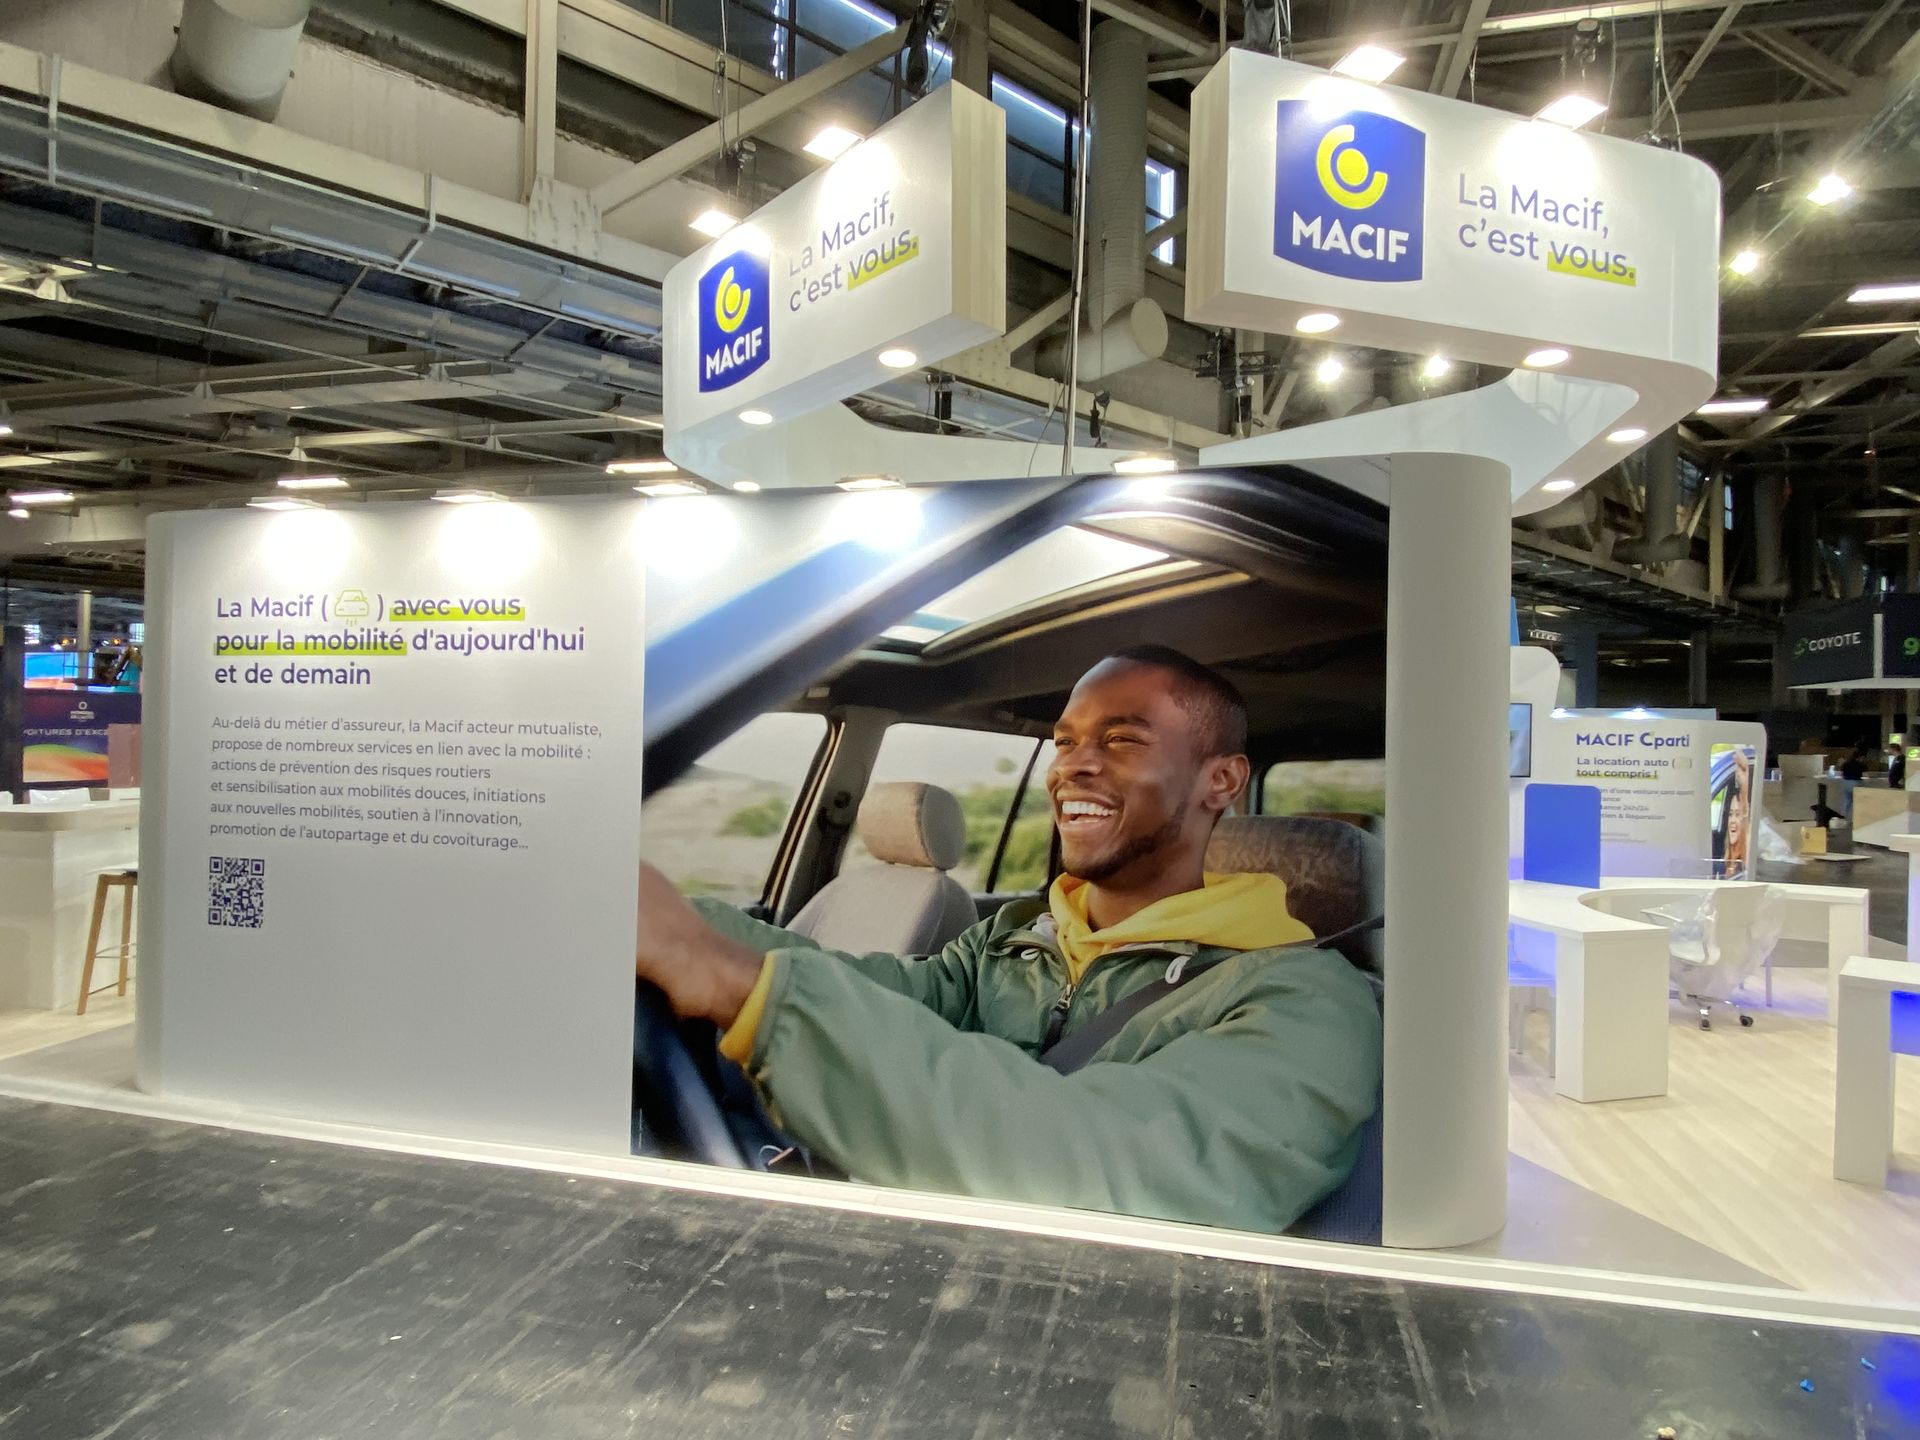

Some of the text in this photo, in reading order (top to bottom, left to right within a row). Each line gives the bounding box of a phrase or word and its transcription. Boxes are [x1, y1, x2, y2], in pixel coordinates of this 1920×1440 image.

[1459, 173, 1609, 239] La Macif,
[788, 190, 895, 277] La Macif,
[1292, 211, 1409, 263] MACIF
[1459, 218, 1635, 279] c'est vous.
[789, 229, 918, 312] c'est vous.
[705, 326, 763, 380] MACIF
[217, 598, 242, 617] La
[251, 594, 314, 617] Macif
[393, 599, 451, 616] avec
[459, 598, 521, 616] vous
[216, 627, 584, 656] pour la mobilité d'aujourd'hui
[1808, 632, 1861, 651] COYOTE
[215, 661, 371, 684] et de demain
[212, 717, 602, 738] Au-delà du métier d'assureur, la Macif acteur mutualiste,
[1576, 733, 1635, 746] MACIF
[212, 739, 263, 752] propose
[266, 738, 282, 751] de
[286, 739, 354, 752] nombreux
[357, 741, 412, 754] services
[416, 743, 433, 754] en
[438, 741, 463, 755] lien
[468, 745, 500, 756] avec
[505, 743, 516, 757] la
[521, 744, 583, 759] mobilité
[211, 760, 491, 779] actions de prévention des risques routiers
[1577, 757, 1590, 765] La
[1594, 756, 1640, 766] location
[1644, 758, 1669, 767] auto
[1577, 769, 1601, 777] tout
[1604, 769, 1651, 779] compris
[211, 780, 546, 804] et sensibilisation aux mobilités douces, initiations
[210, 803, 522, 828] aux nouvelles mobilités, soutien à l'innovation,
[210, 823, 528, 851] promotion de l'autopartage et du covoiturage...
